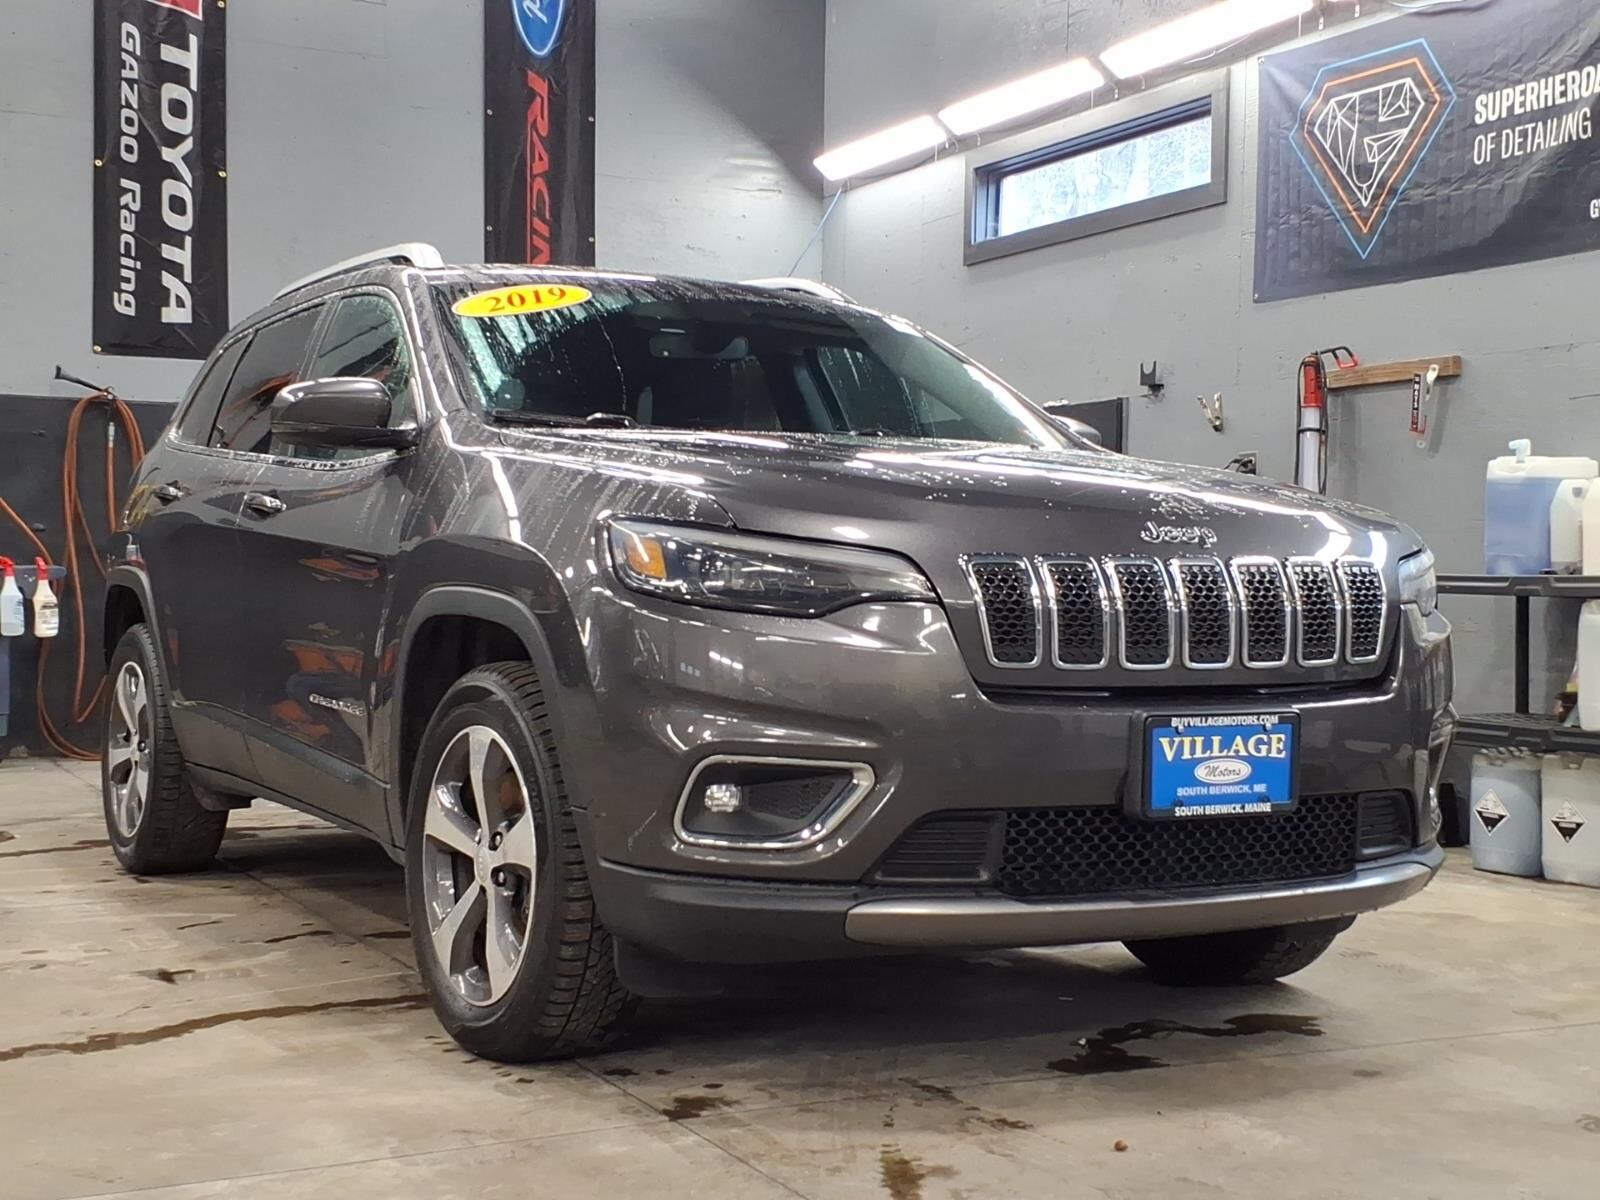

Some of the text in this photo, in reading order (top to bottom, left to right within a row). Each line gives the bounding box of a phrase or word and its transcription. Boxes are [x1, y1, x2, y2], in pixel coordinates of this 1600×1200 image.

[1473, 106, 1592, 165] OF DETAILING
[113, 21, 141, 317] GAZOO Racing
[160, 33, 198, 324] TOYOTA
[527, 67, 550, 264] RACIN
[485, 286, 567, 313] 2019
[1140, 521, 1217, 549] Jeep
[1171, 714, 1279, 728] BUYVILLAGEMOTORS.COM
[1158, 733, 1286, 762] VILLAGE
[1204, 765, 1242, 778] Motors
[1176, 786, 1208, 797] SOUTH
[1253, 783, 1267, 793] ME
[1174, 805, 1204, 817] SOUTH
[1244, 802, 1272, 813] MAINE
